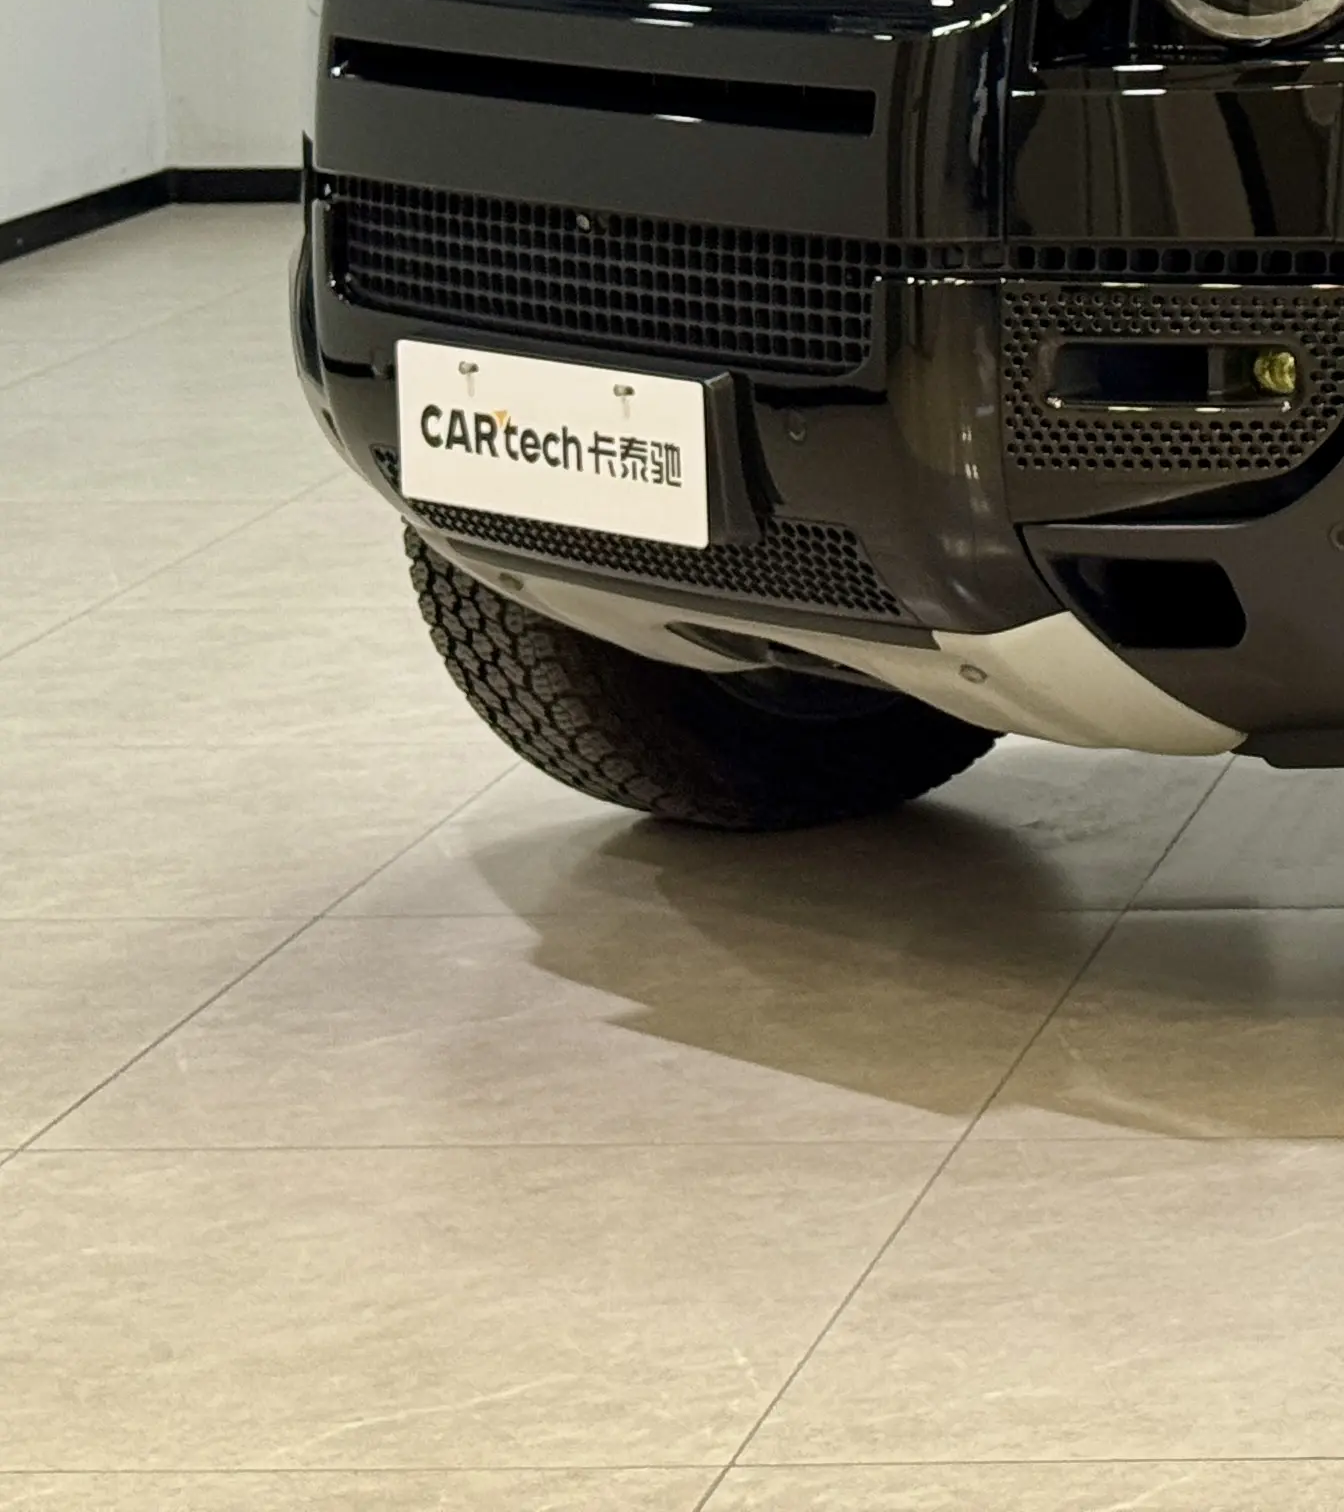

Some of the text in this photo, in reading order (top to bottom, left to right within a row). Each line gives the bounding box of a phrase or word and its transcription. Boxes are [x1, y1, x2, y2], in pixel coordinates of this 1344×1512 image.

[420, 403, 683, 488] CARtech 卡泰驰
